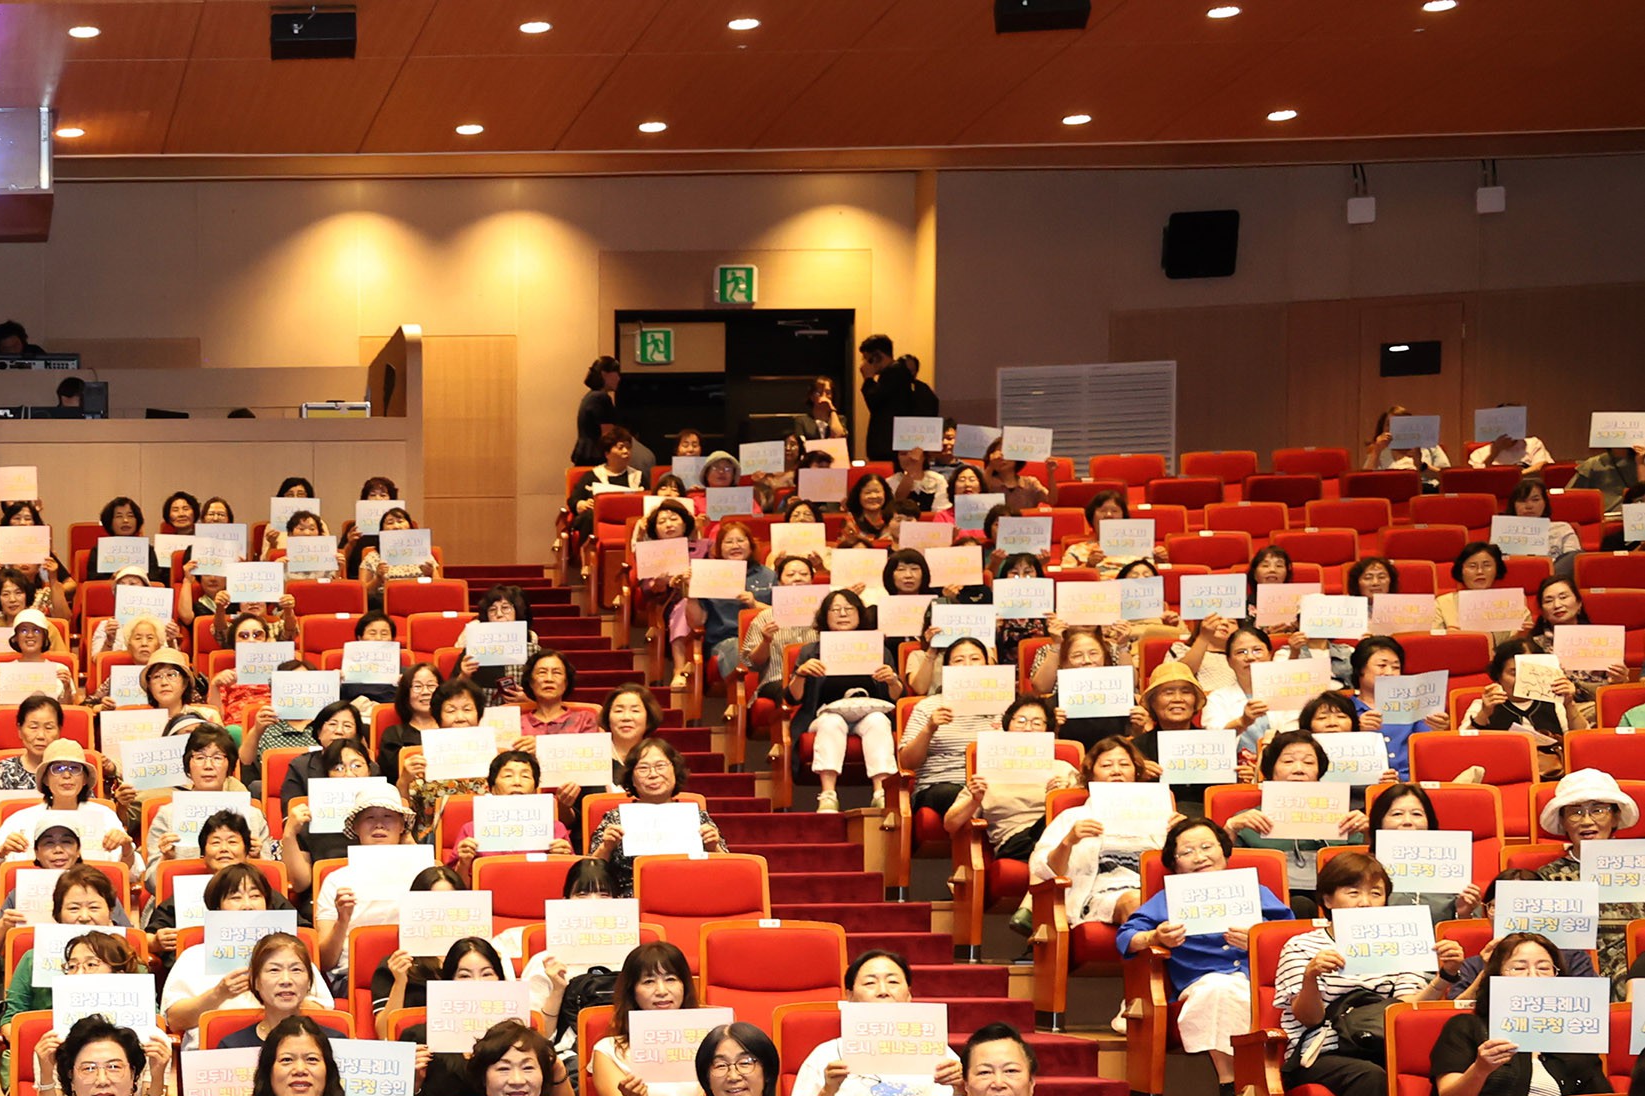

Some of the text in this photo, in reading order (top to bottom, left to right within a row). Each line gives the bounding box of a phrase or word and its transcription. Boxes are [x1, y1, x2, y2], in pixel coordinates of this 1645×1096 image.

[1509, 996, 1591, 1013] 화성특례시
[1500, 1016, 1600, 1034] 4개 구청 승인
[683, 1028, 710, 1044] 평등
[666, 1047, 696, 1062] 빛나
